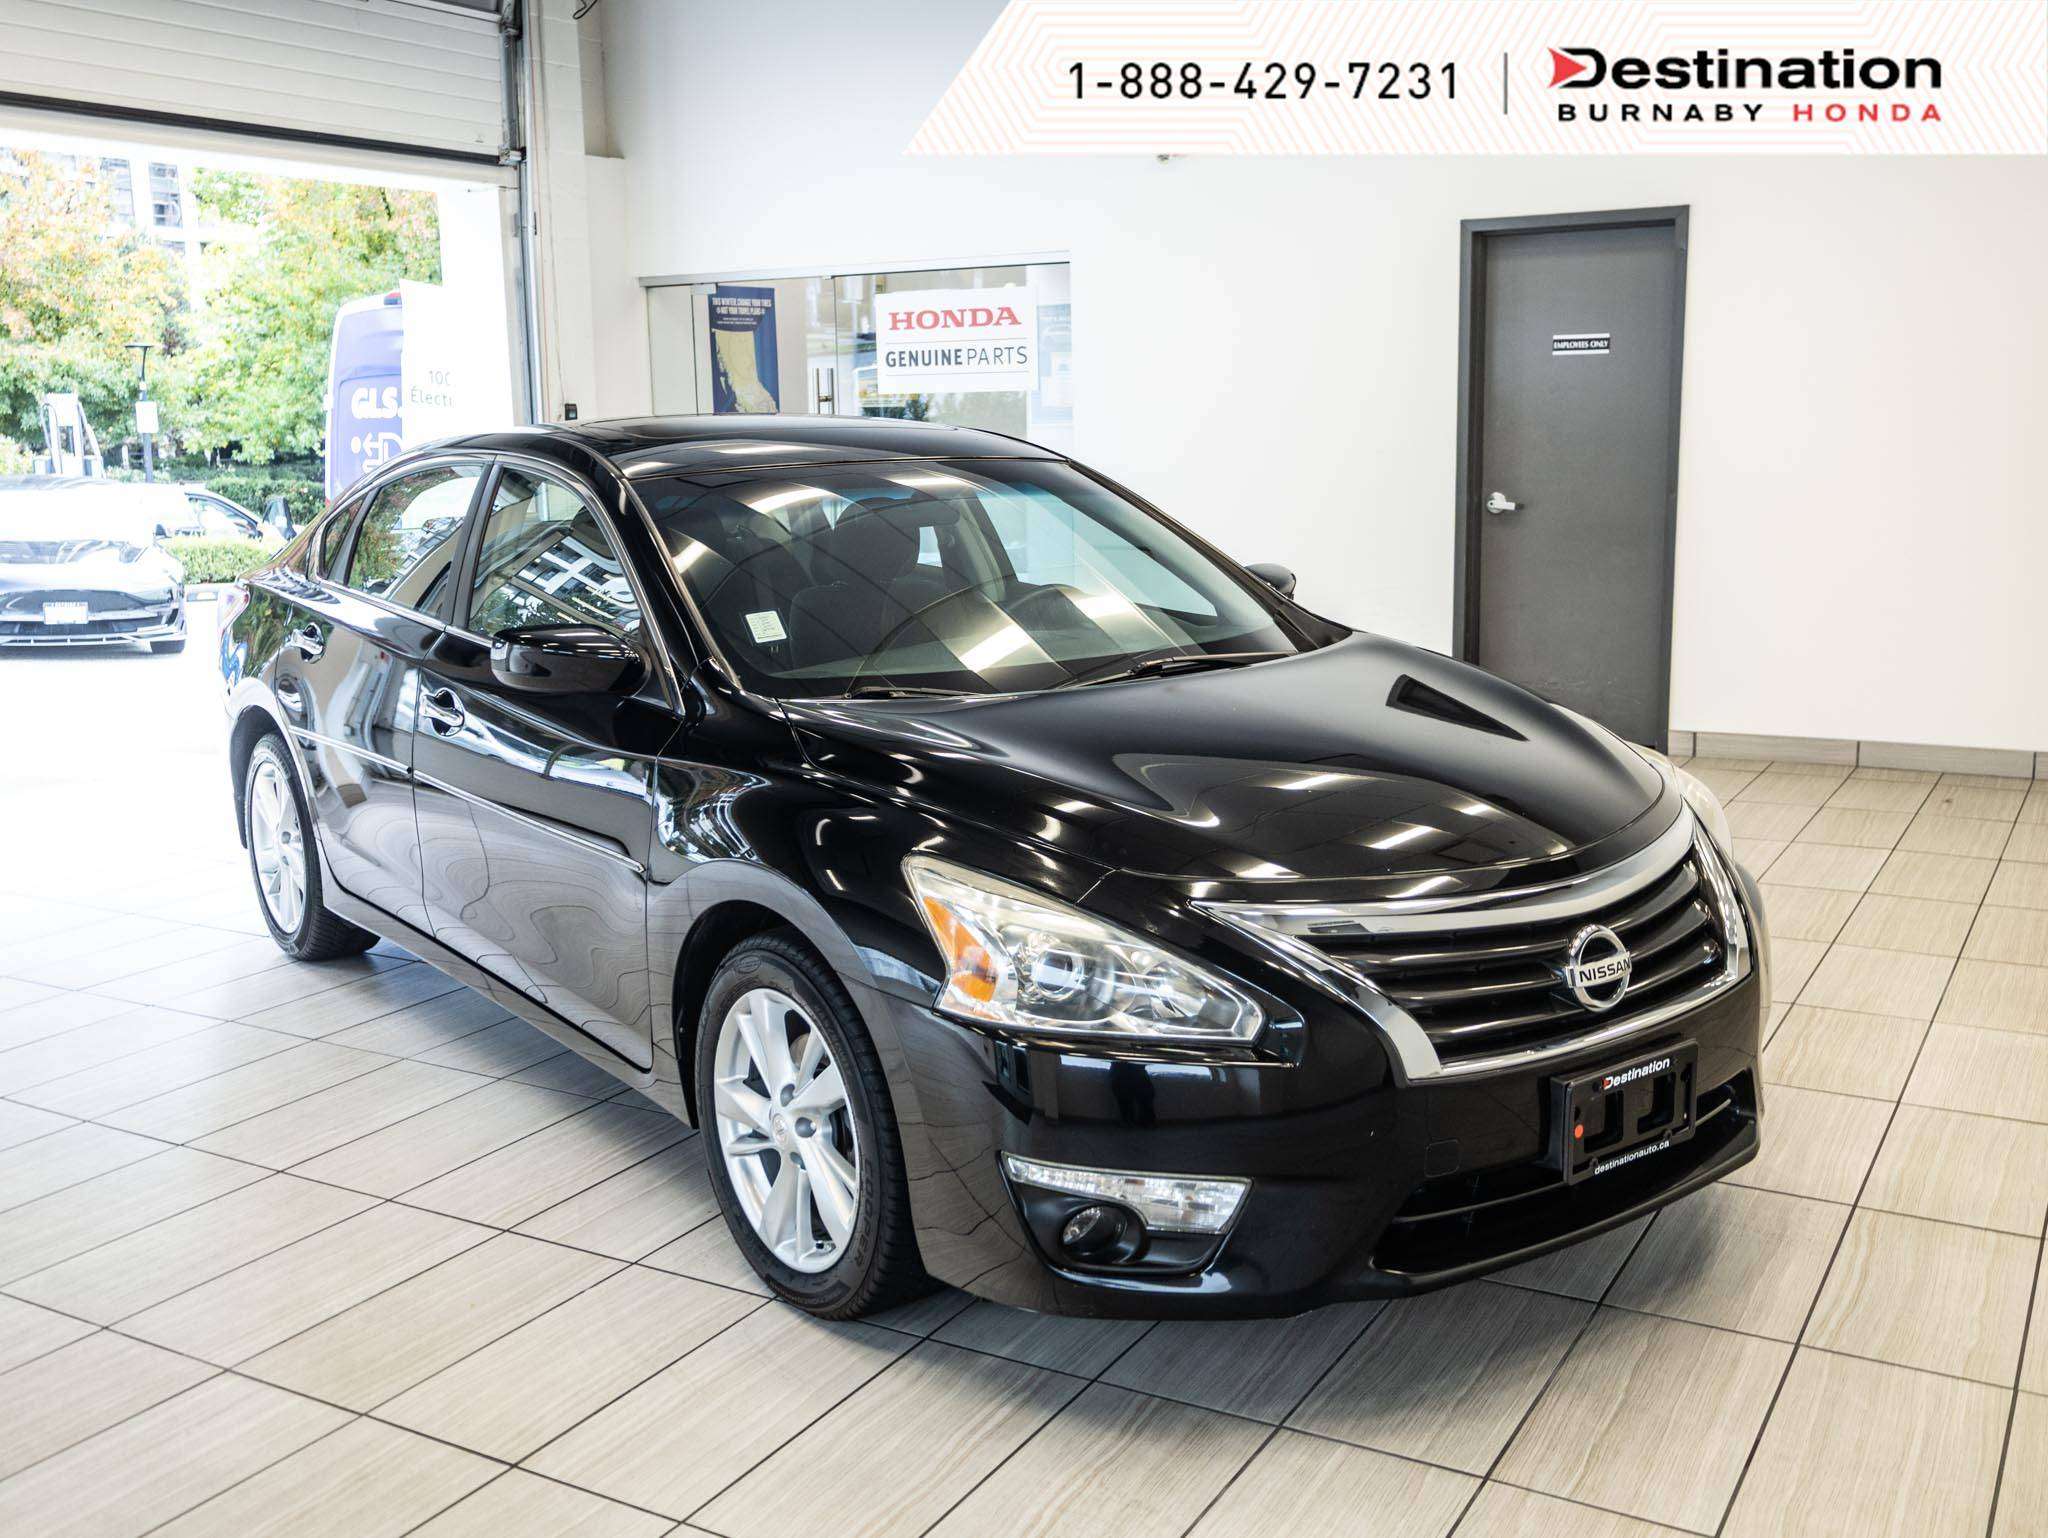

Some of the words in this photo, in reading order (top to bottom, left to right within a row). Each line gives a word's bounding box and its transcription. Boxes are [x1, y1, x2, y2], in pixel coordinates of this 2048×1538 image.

[888, 306, 1022, 331] HONDA
[1579, 957, 1631, 983] NISSAN
[1602, 1058, 1671, 1090] Destination
[1594, 1139, 1670, 1175] destinationauto.ca
